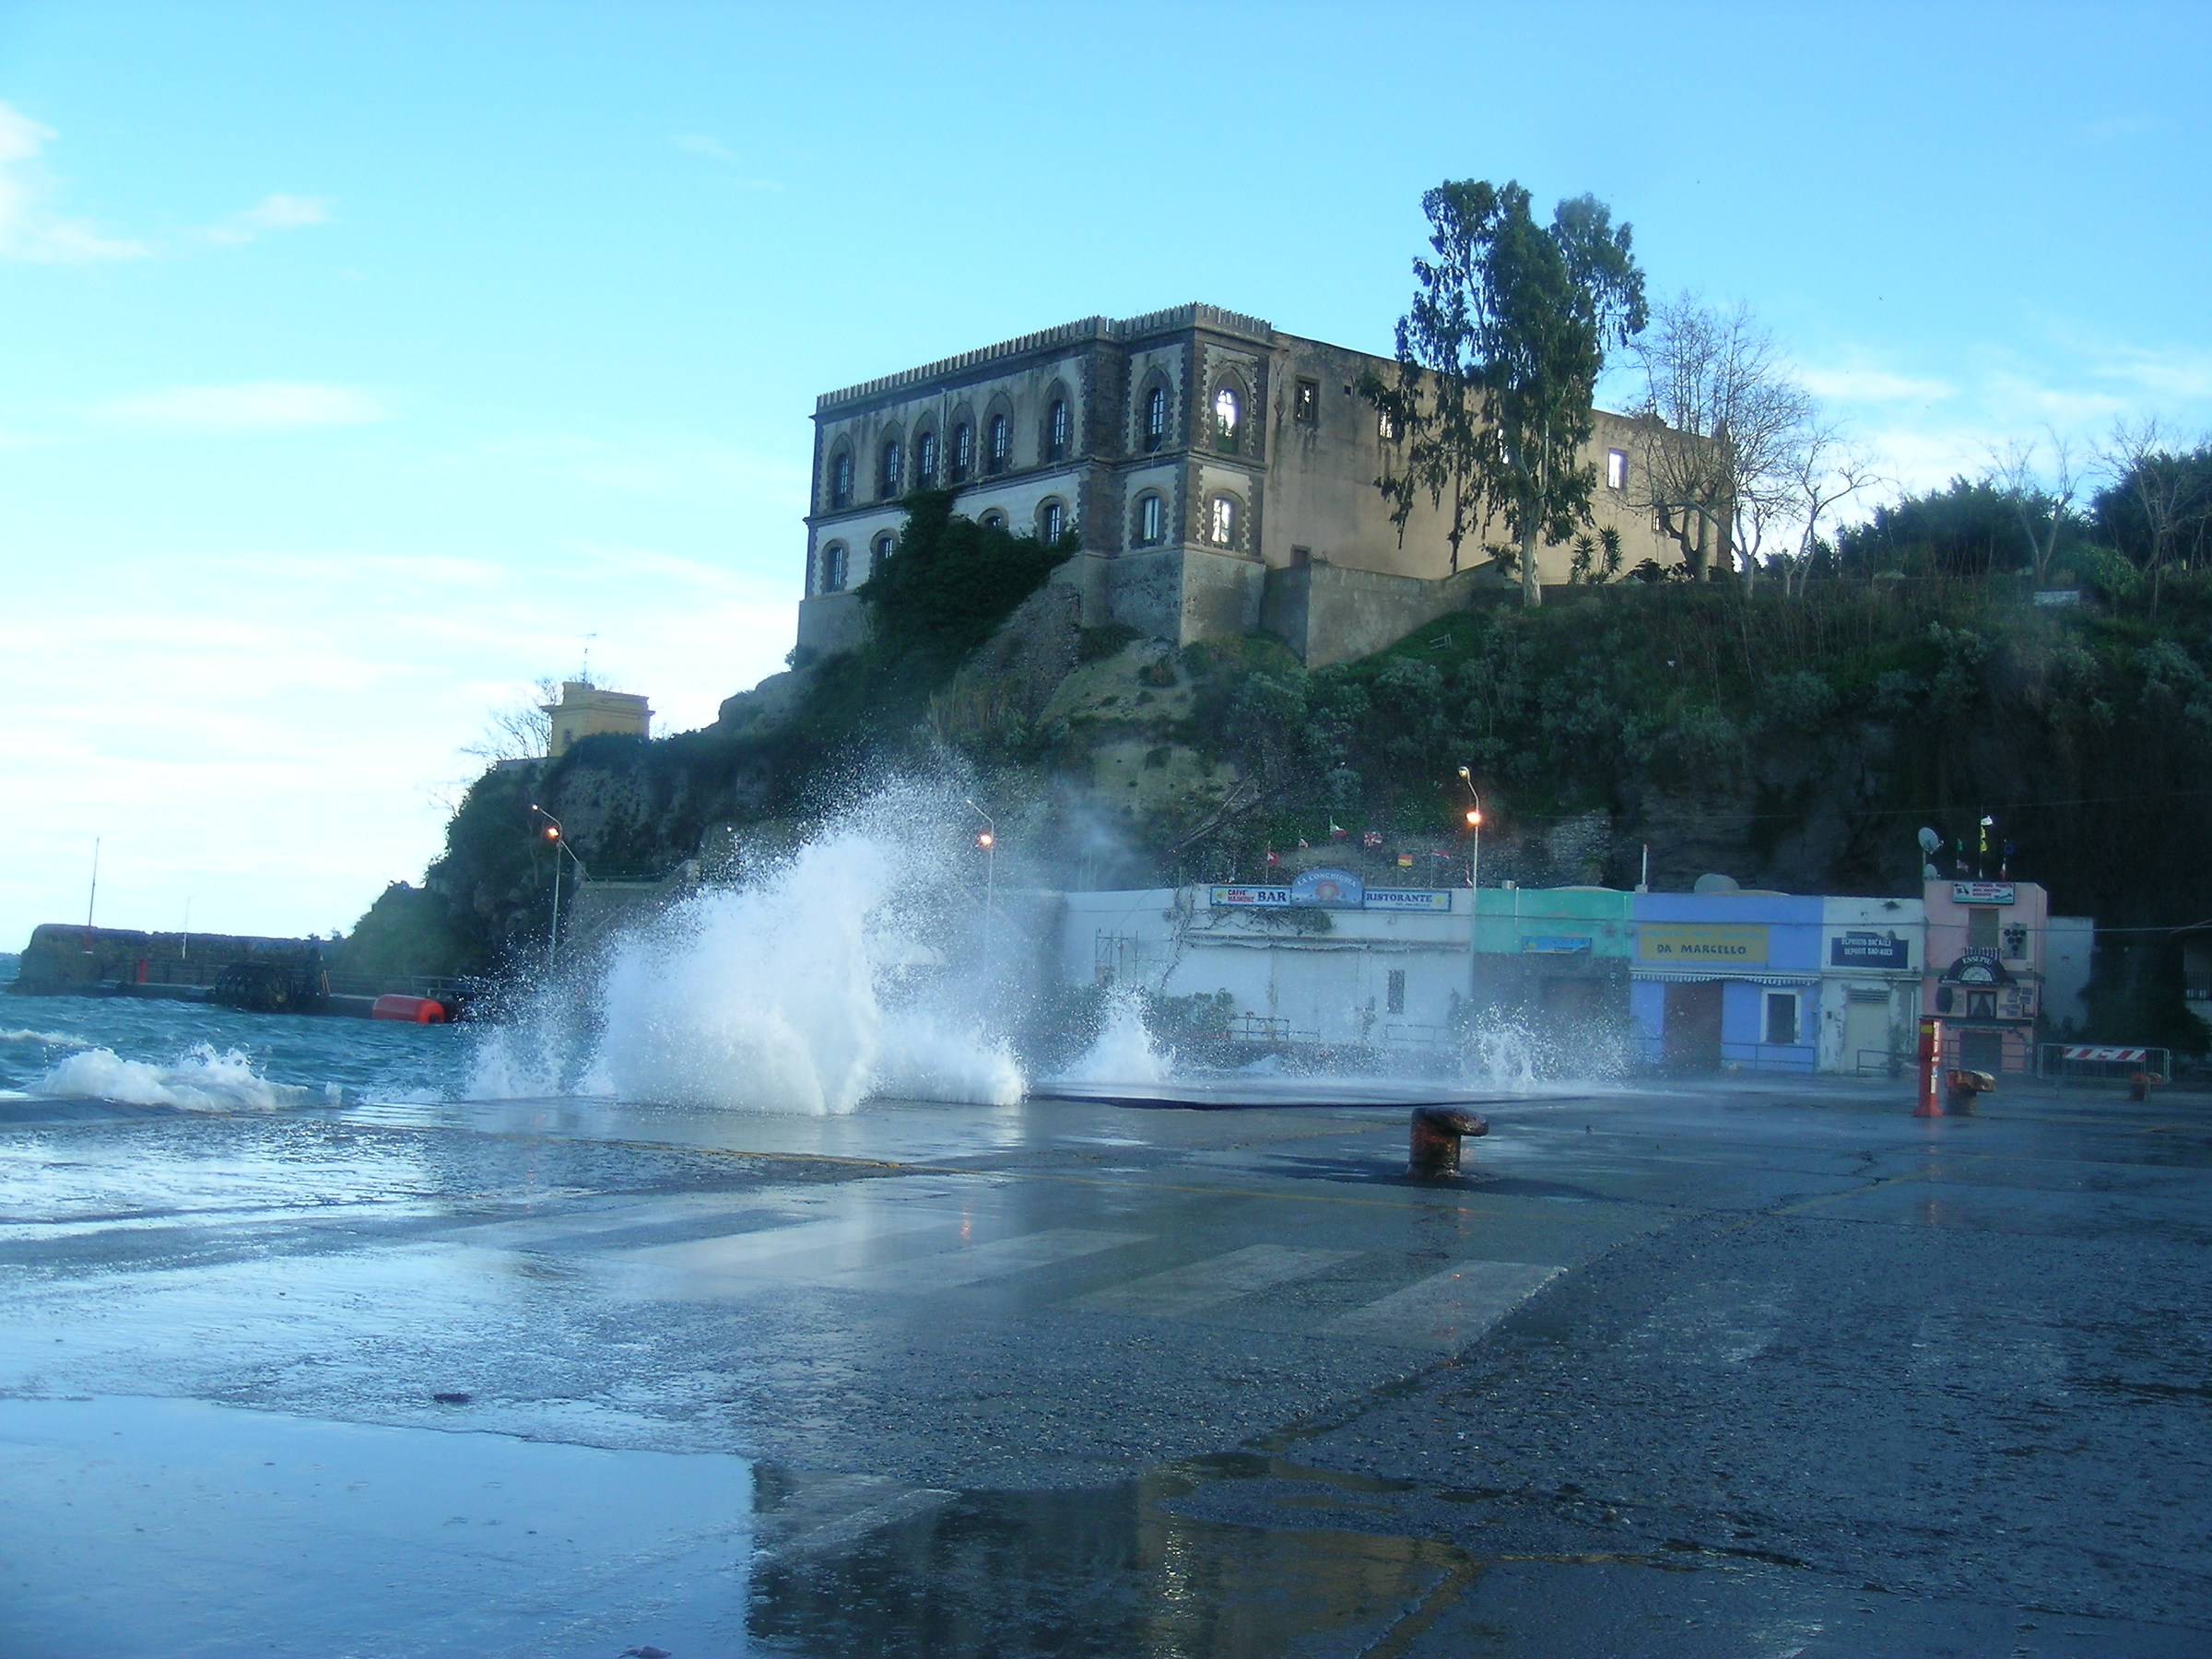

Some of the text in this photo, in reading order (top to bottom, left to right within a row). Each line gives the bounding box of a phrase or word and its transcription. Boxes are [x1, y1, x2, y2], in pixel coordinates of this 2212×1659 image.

[1257, 891, 1287, 902] BAR
[1366, 893, 1432, 902] RISTORANTE
[1657, 944, 1747, 955] DA MARCELLO
